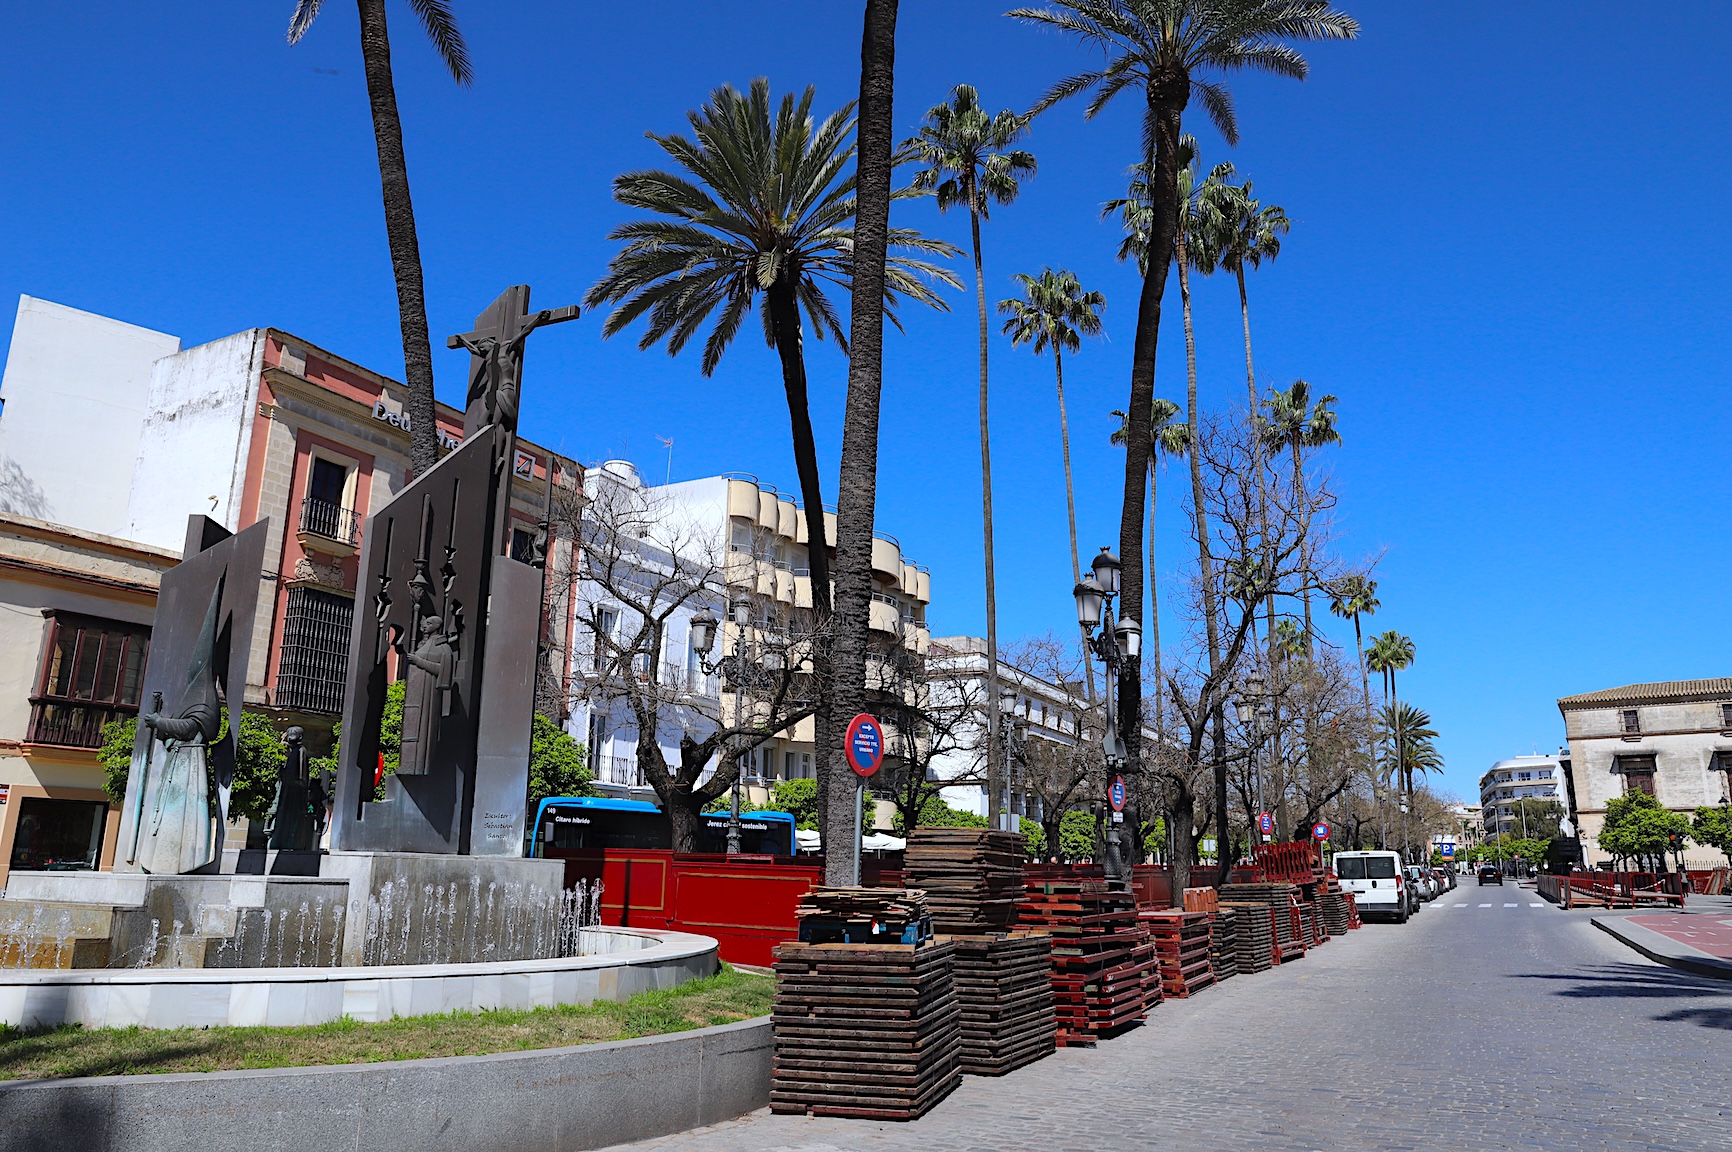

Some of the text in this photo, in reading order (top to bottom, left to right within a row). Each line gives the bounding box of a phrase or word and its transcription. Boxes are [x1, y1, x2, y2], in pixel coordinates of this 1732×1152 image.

[371, 401, 461, 450] Deuhe
[555, 815, 572, 823] Citaro
[707, 819, 722, 828] Jerez
[742, 822, 768, 830] sostenible
[1443, 844, 1450, 853] P
